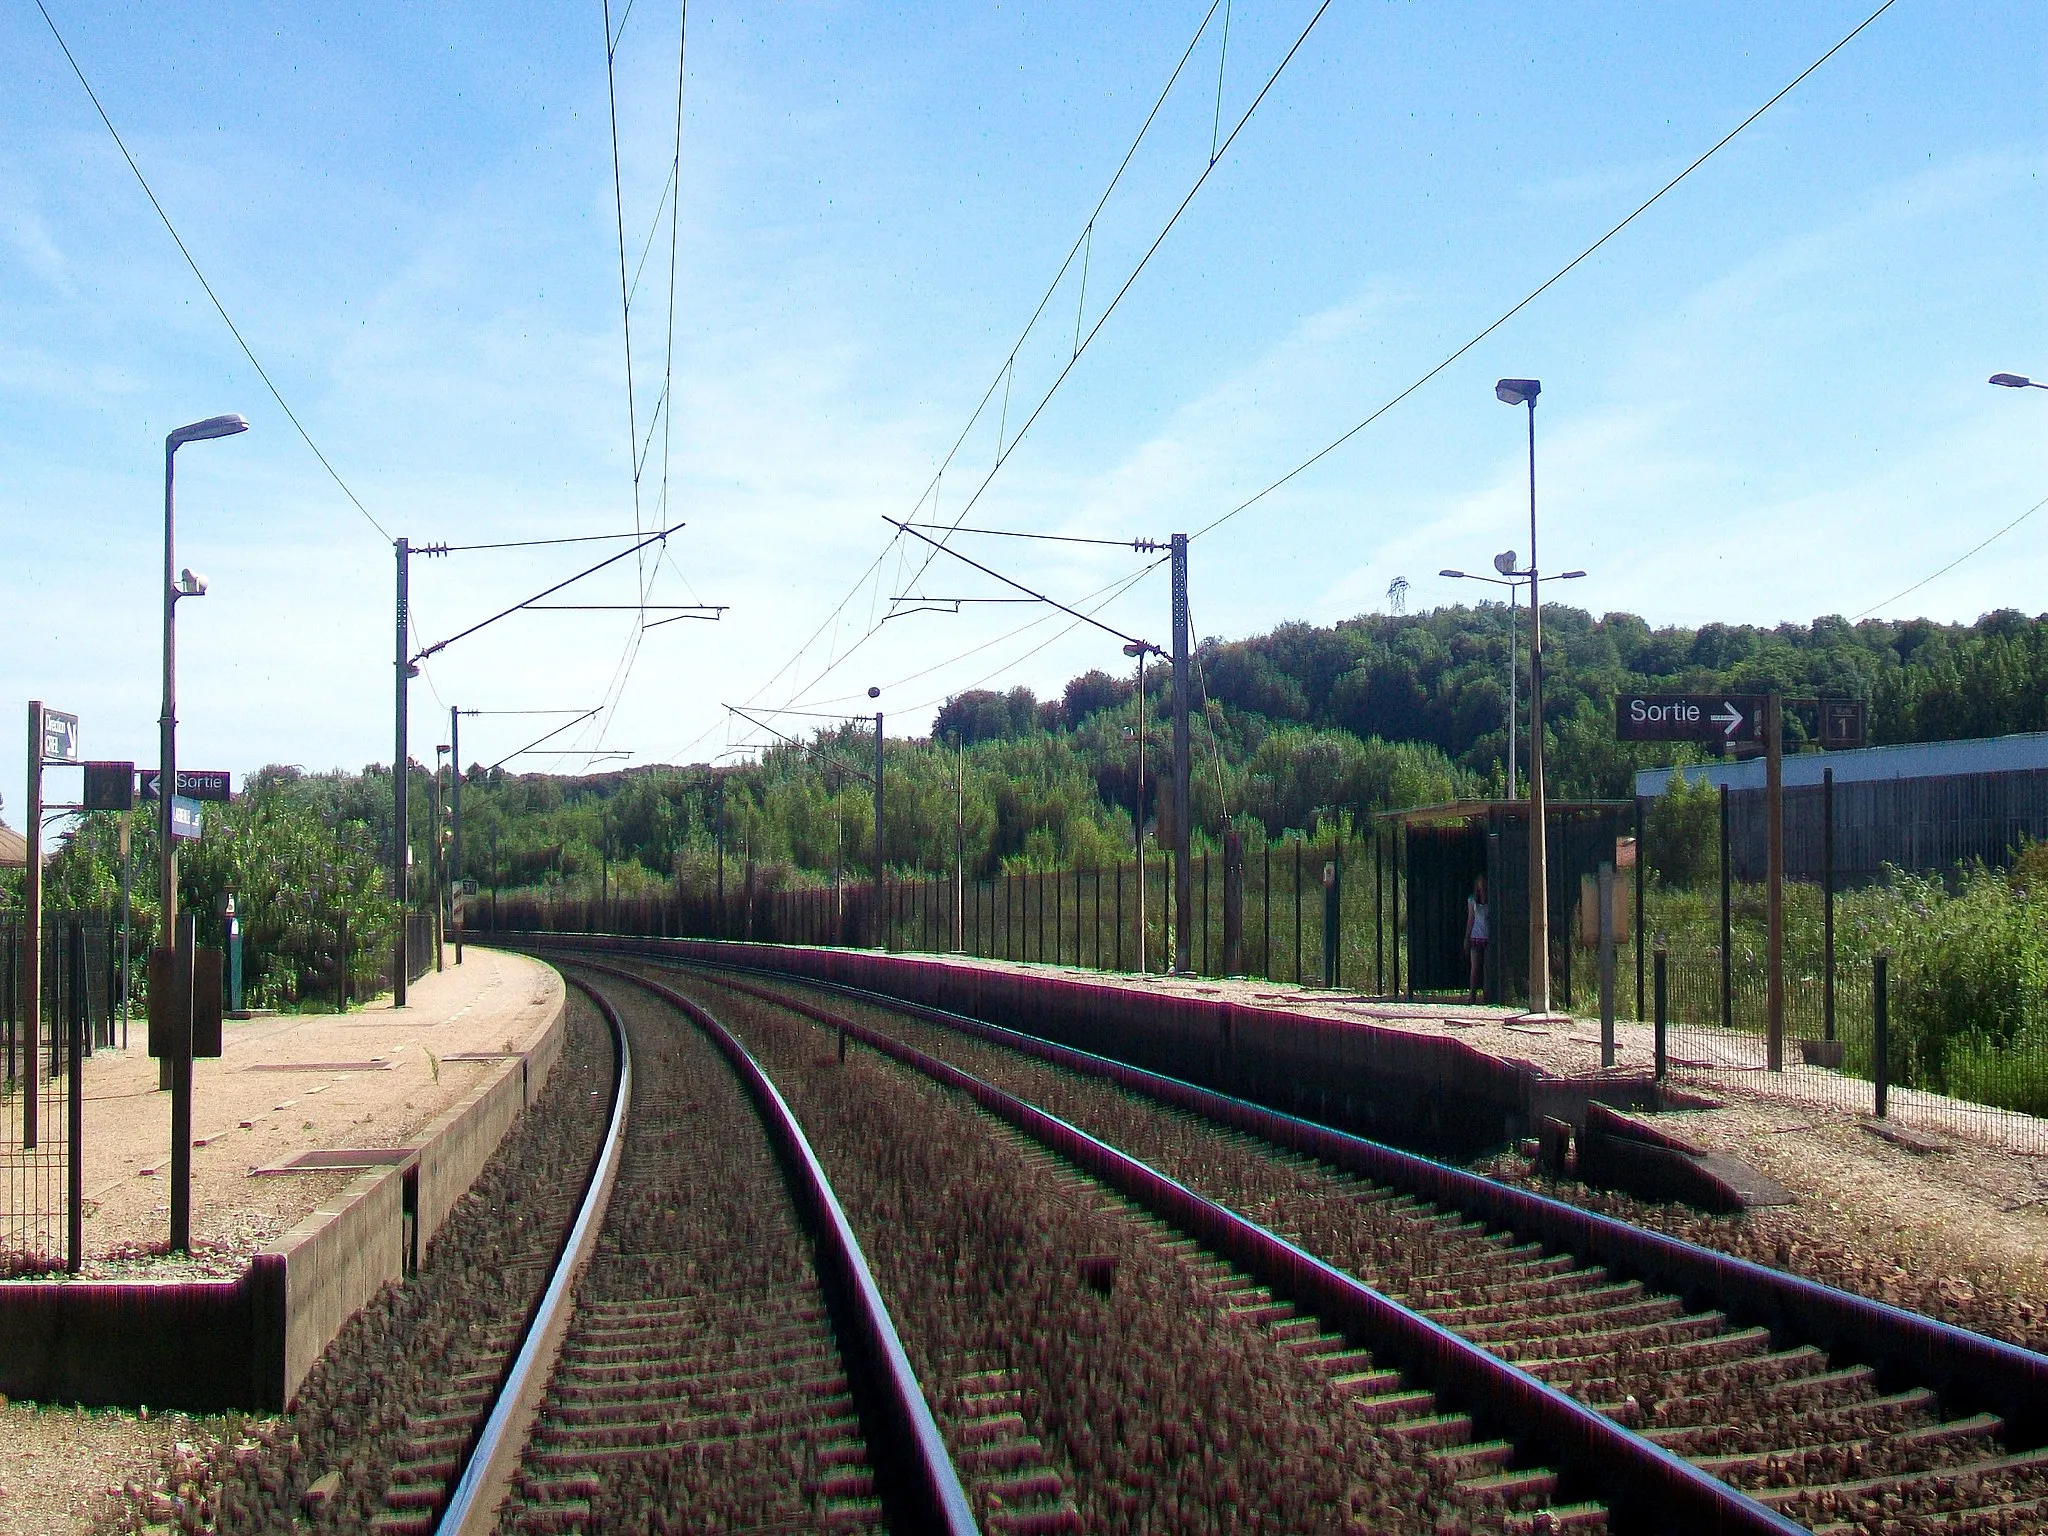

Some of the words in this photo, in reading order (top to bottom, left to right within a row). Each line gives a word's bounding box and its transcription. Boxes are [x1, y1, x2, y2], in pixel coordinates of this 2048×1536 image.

[1630, 699, 1700, 722] Sortie
[1838, 717, 1848, 738] 1
[177, 773, 222, 789] Sortie
